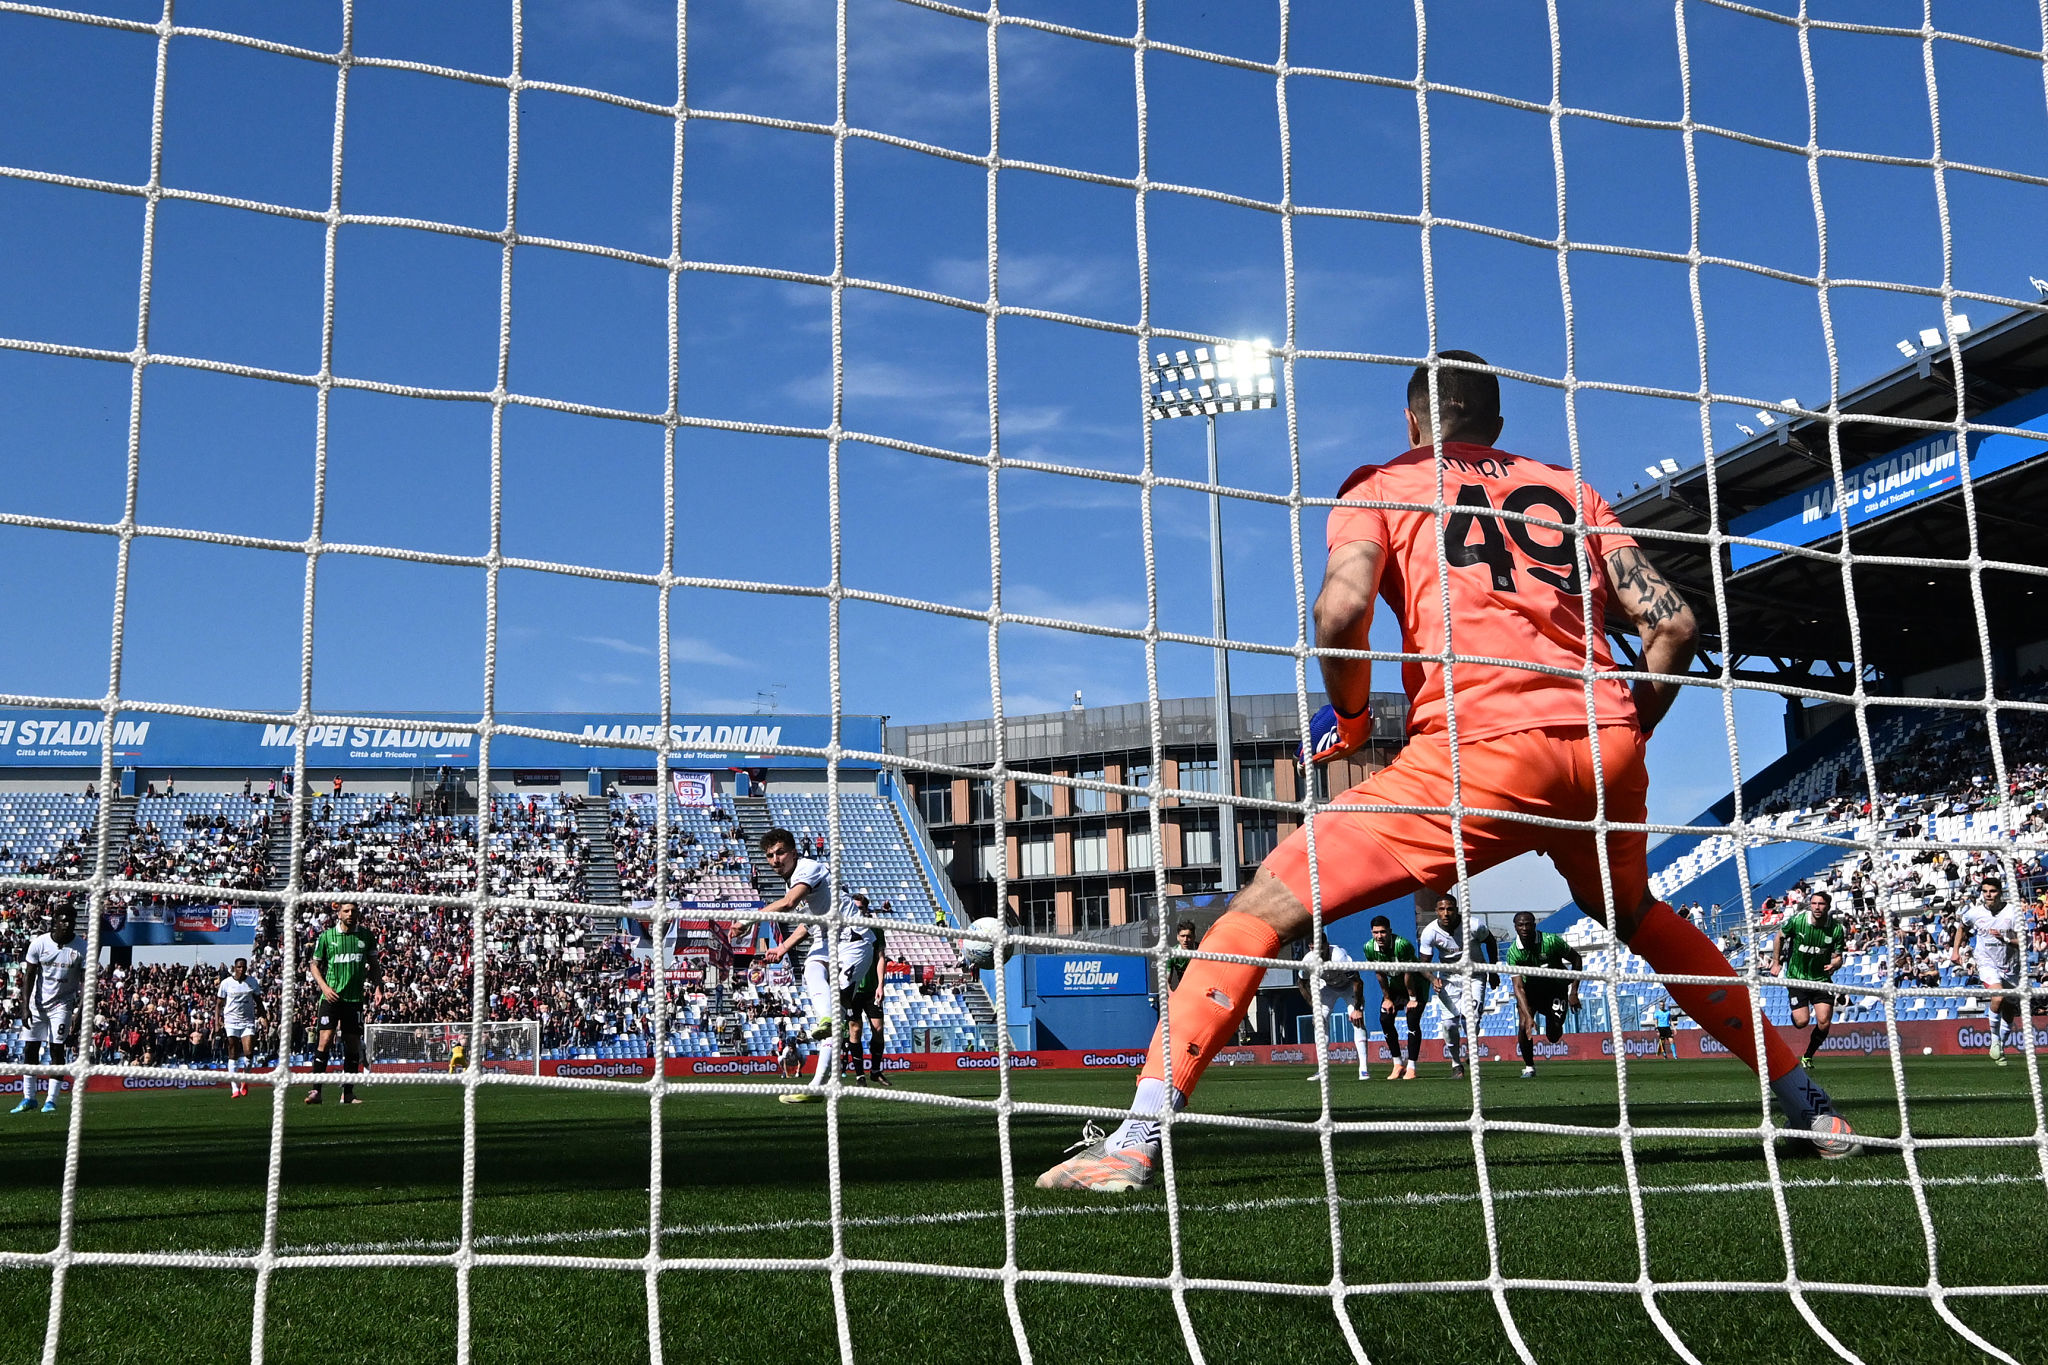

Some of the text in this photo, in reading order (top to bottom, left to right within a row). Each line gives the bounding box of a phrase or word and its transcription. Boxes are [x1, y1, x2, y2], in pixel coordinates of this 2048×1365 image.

[1863, 434, 1957, 500] STADIUM
[1444, 484, 1592, 596] 49
[675, 773, 709, 783] CAGLIARI
[1064, 961, 1102, 973] MAPEI
[1064, 972, 1119, 985] STADIUM
[57, 1024, 66, 1036] 8
[556, 1063, 644, 1077] GiocoDigitale
[693, 1061, 778, 1075] GiocoDigitale
